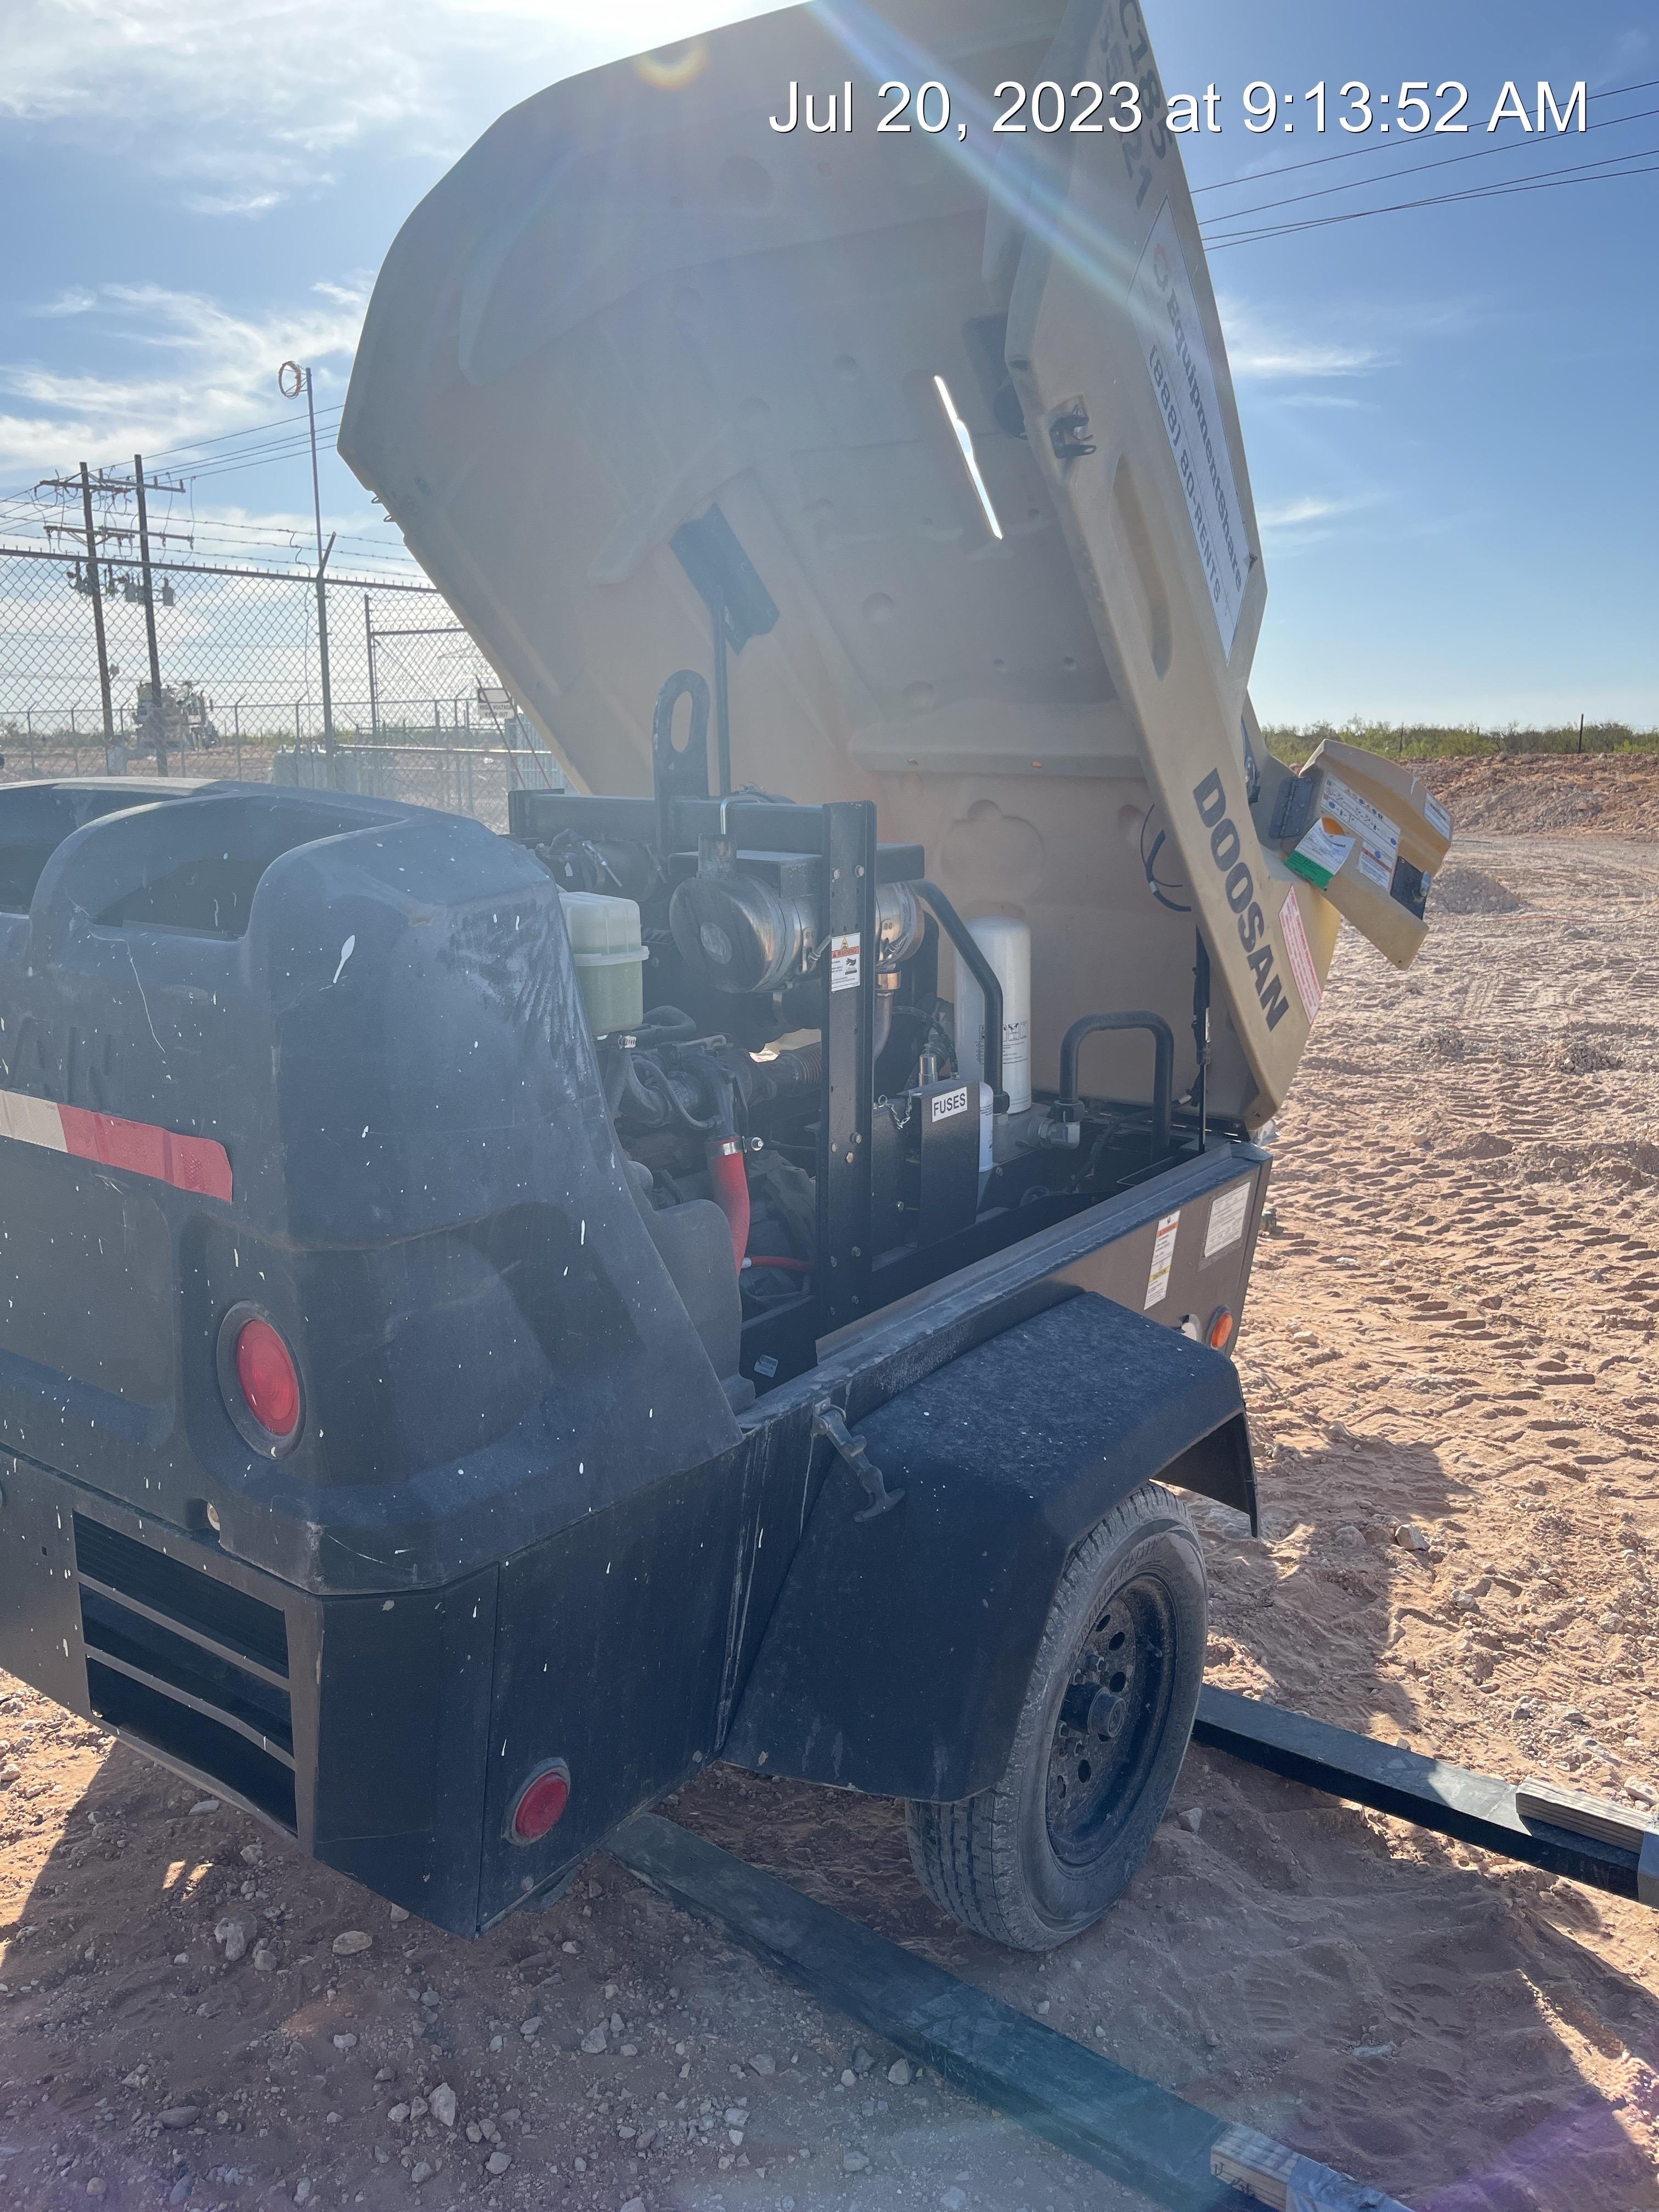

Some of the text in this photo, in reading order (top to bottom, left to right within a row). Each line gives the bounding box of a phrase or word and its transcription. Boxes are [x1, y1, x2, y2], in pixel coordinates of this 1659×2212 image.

[1149, 344, 1221, 603] (888) 80-RENTS
[1166, 287, 1242, 592] EquipmentShare
[1193, 768, 1289, 1031] DOOSAN
[934, 1093, 966, 1116] FUSES
